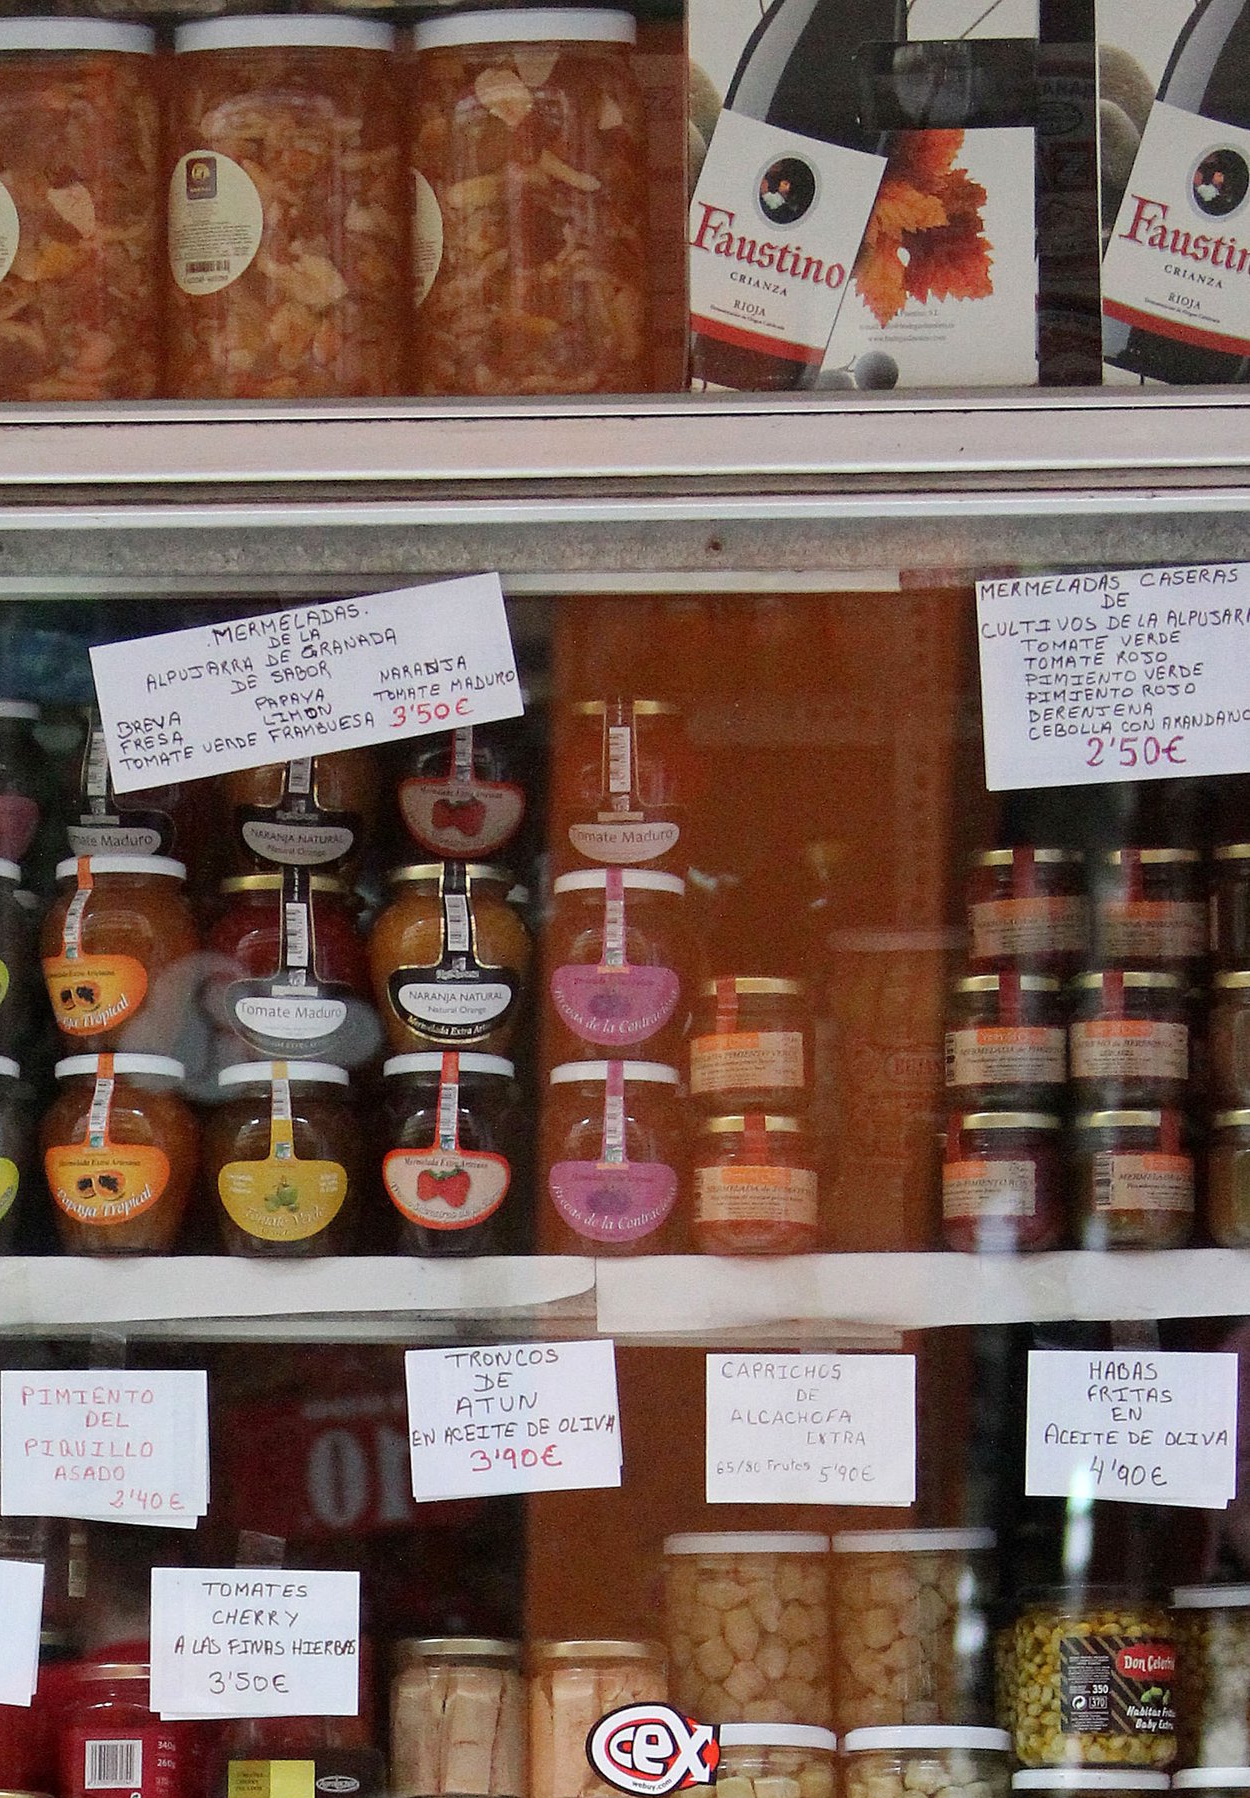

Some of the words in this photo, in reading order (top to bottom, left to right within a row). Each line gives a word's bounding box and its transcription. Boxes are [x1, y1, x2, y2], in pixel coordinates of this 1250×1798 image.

[689, 199, 845, 289] Faustino
[730, 271, 788, 296] CRIANZA
[1164, 263, 1223, 289] CRIANZA
[733, 299, 766, 317] RIOJA
[1168, 291, 1201, 310] RIOJA
[980, 574, 1120, 600] MERMELADAS
[1140, 568, 1238, 587] CASERAS
[1021, 636, 1108, 652] TOMATE
[1122, 631, 1180, 646] VERDE
[1024, 653, 1105, 670] TOMATE
[146, 658, 254, 692] ALPUJARRA
[1025, 671, 1136, 686] PIMIENTO
[409, 990, 456, 1003] NARANJA
[459, 990, 504, 1001] NATURAL
[240, 1003, 292, 1018] Tomate
[295, 1005, 342, 1018] Maduro
[427, 1005, 458, 1013] Natural
[461, 1005, 487, 1013] Orange
[444, 1348, 560, 1370] TRONCOS
[1089, 1361, 1158, 1380] HABAS
[21, 1385, 154, 1406] PIMIENTO
[455, 1392, 538, 1415] ATUN
[1088, 1385, 1173, 1403] FRITAS
[444, 1421, 516, 1444] ACEITE
[1044, 1423, 1119, 1445] ACEITE
[1165, 1429, 1228, 1446] OLIVA
[25, 1438, 154, 1459] PIQUILLO
[54, 1464, 126, 1482] ASADO
[202, 1582, 308, 1598] TOMATES
[212, 1609, 299, 1628] CHERRY
[228, 1638, 285, 1656] FINAS
[1124, 1654, 1147, 1672] Don
[1092, 1684, 1108, 1694] 350
[1135, 1719, 1157, 1731] Baby
[631, 1777, 672, 1792] webuy.com
